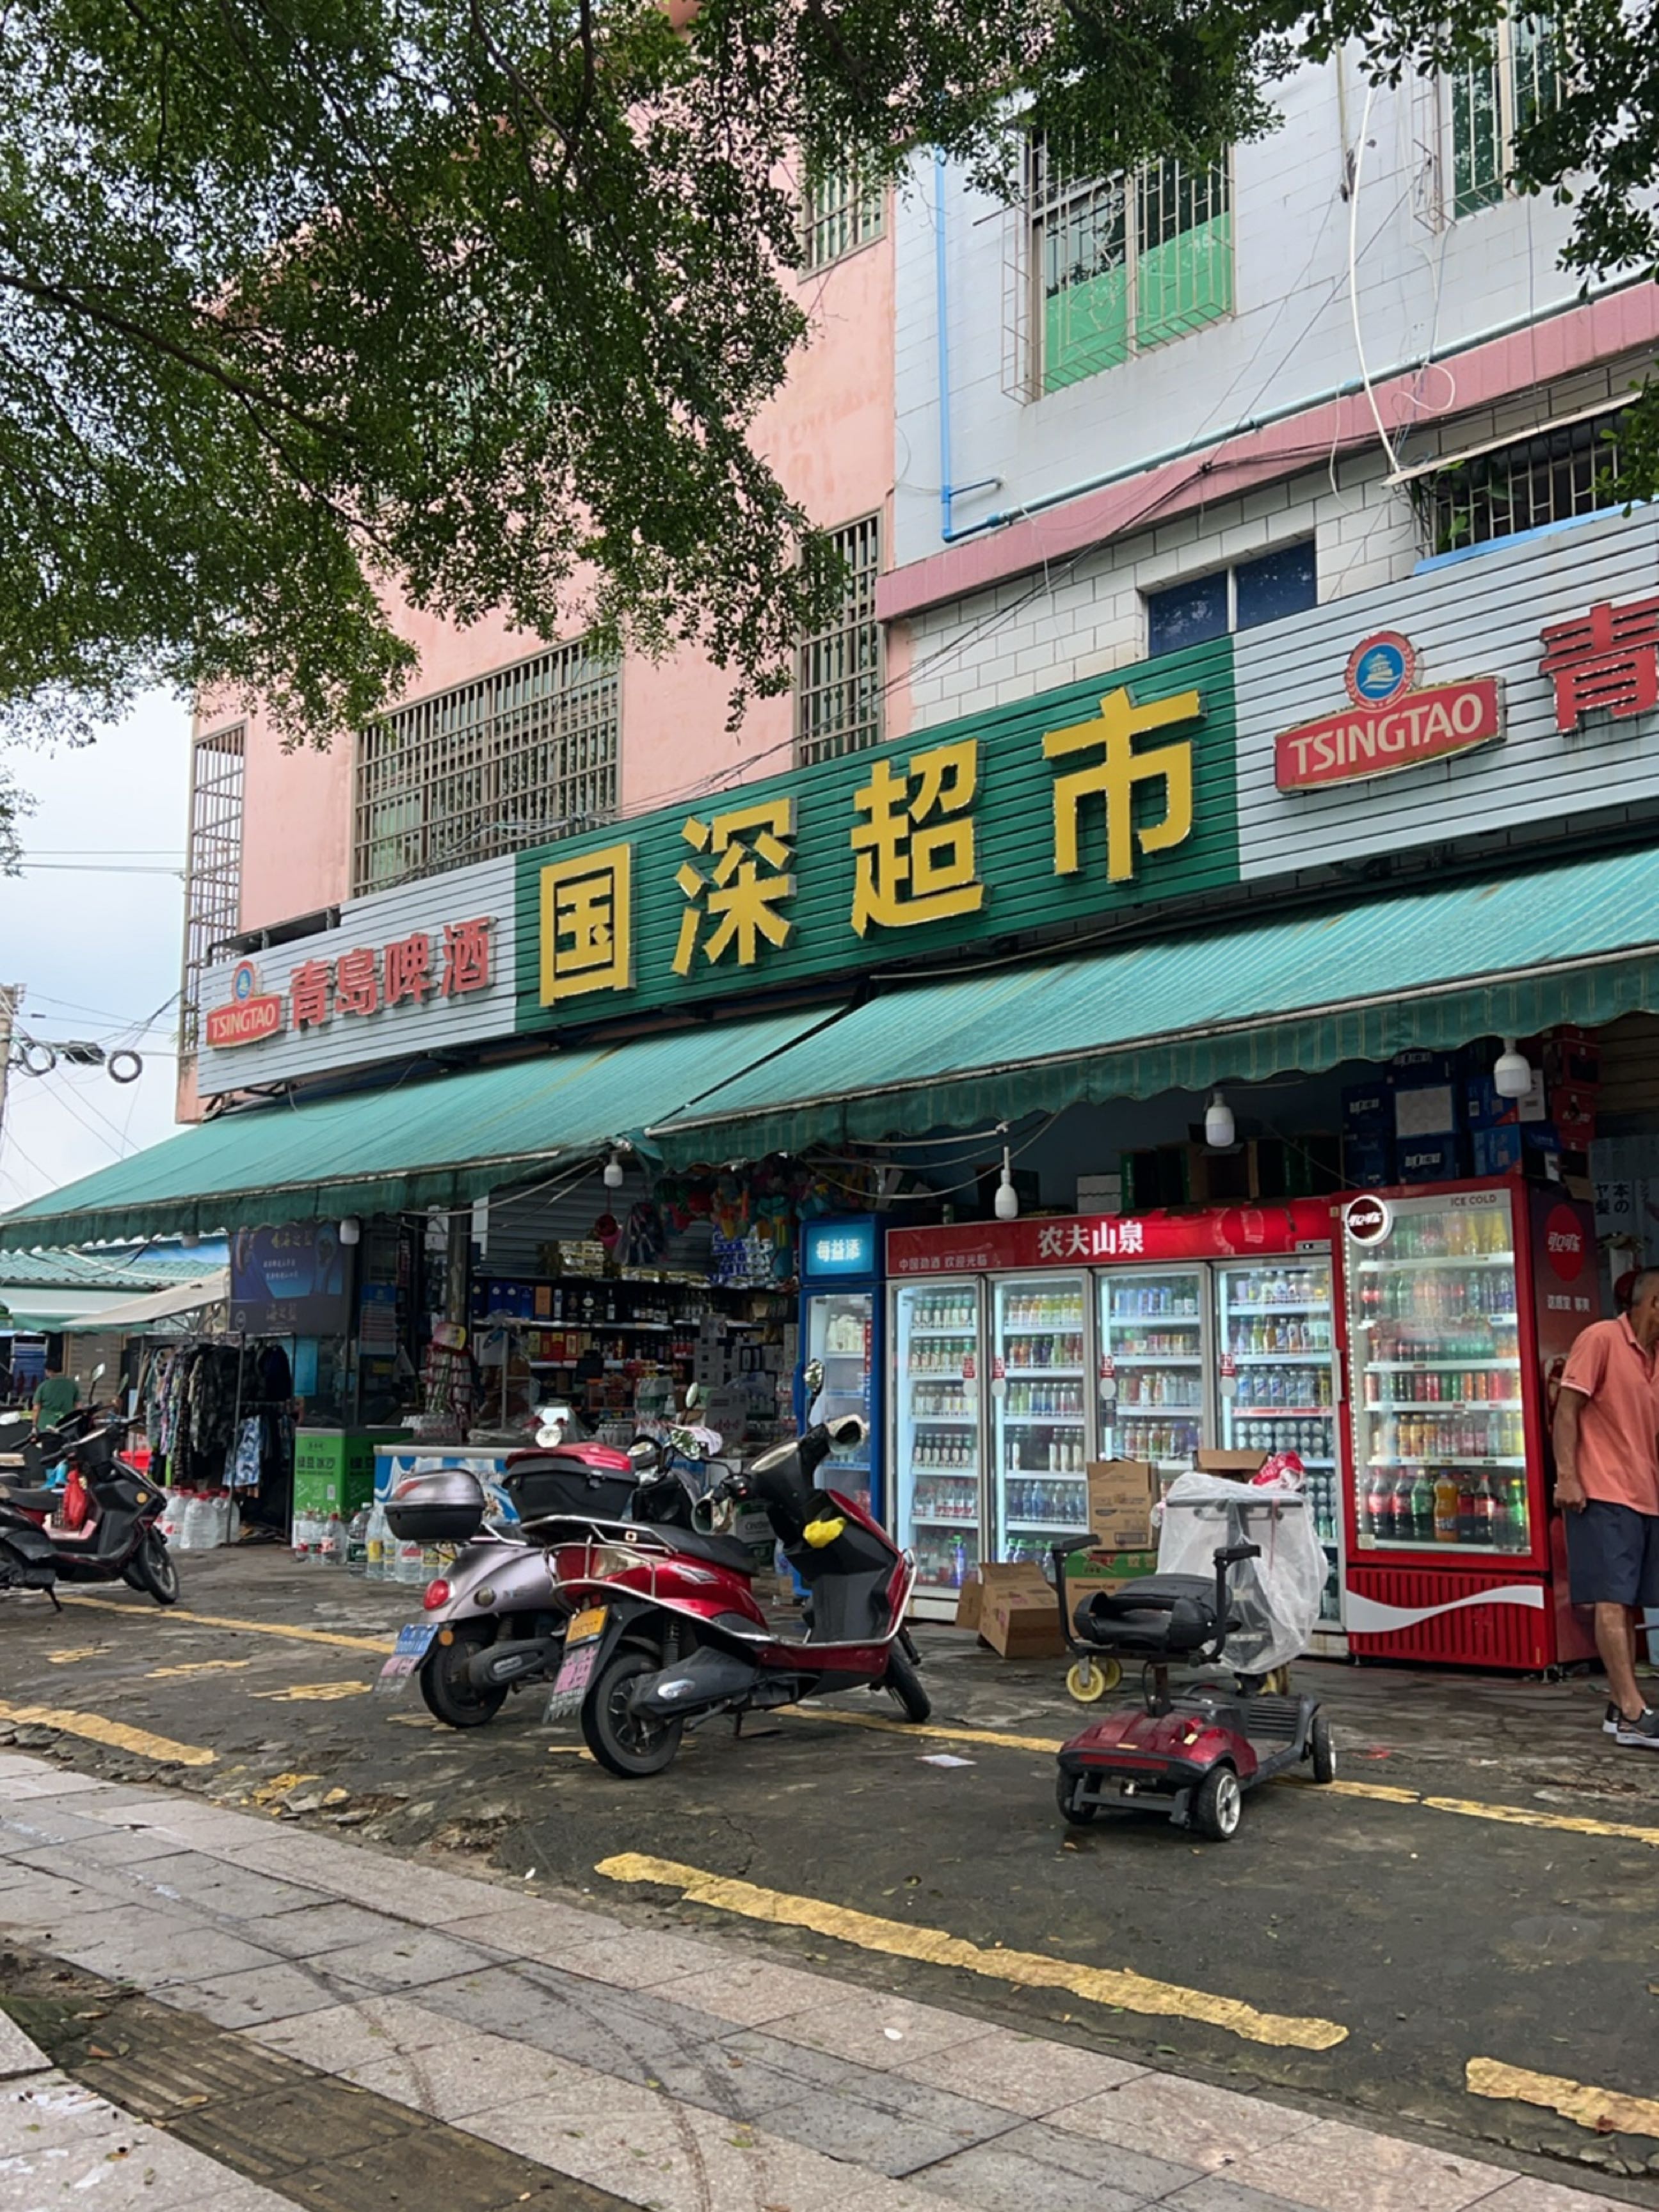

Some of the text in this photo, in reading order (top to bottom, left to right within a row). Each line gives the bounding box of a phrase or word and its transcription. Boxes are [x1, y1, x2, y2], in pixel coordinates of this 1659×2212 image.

[1288, 694, 1483, 775] TSINGTAO
[539, 686, 1199, 1006] 国深超市
[212, 1007, 276, 1040] TSINGTAO
[1450, 1194, 1496, 1206] ICE COLD
[816, 1238, 862, 1262] 每益添
[1038, 1220, 1144, 1258] 农夫山泉
[945, 1254, 988, 1269] 欢迎光临
